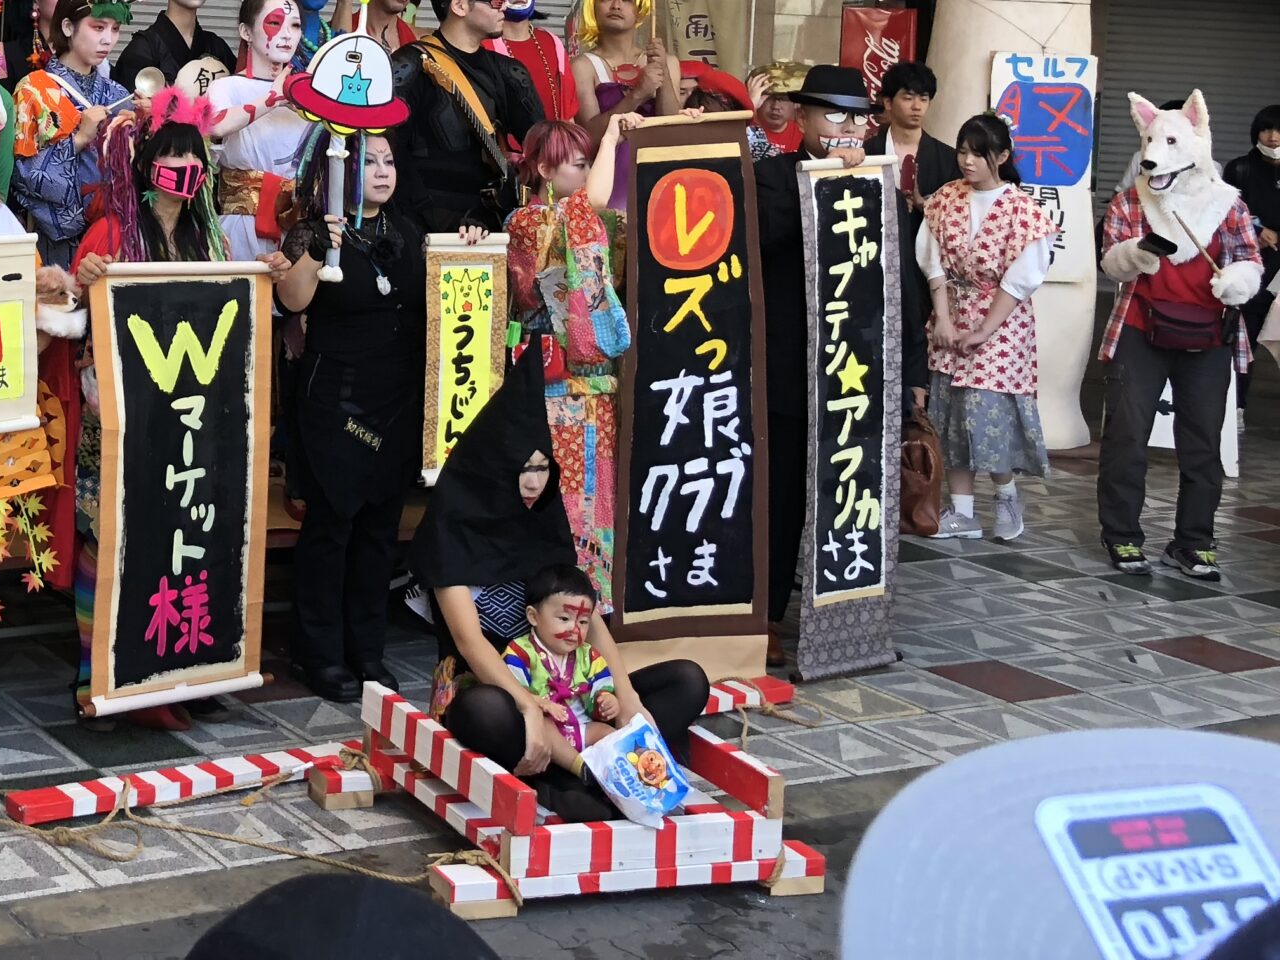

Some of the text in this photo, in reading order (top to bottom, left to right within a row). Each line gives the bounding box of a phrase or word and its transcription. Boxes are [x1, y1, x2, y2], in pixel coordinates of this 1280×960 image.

[1005, 52, 1090, 83] セルフ
[996, 84, 1090, 178] 祭
[644, 538, 720, 600] さま
[822, 525, 875, 583] さま
